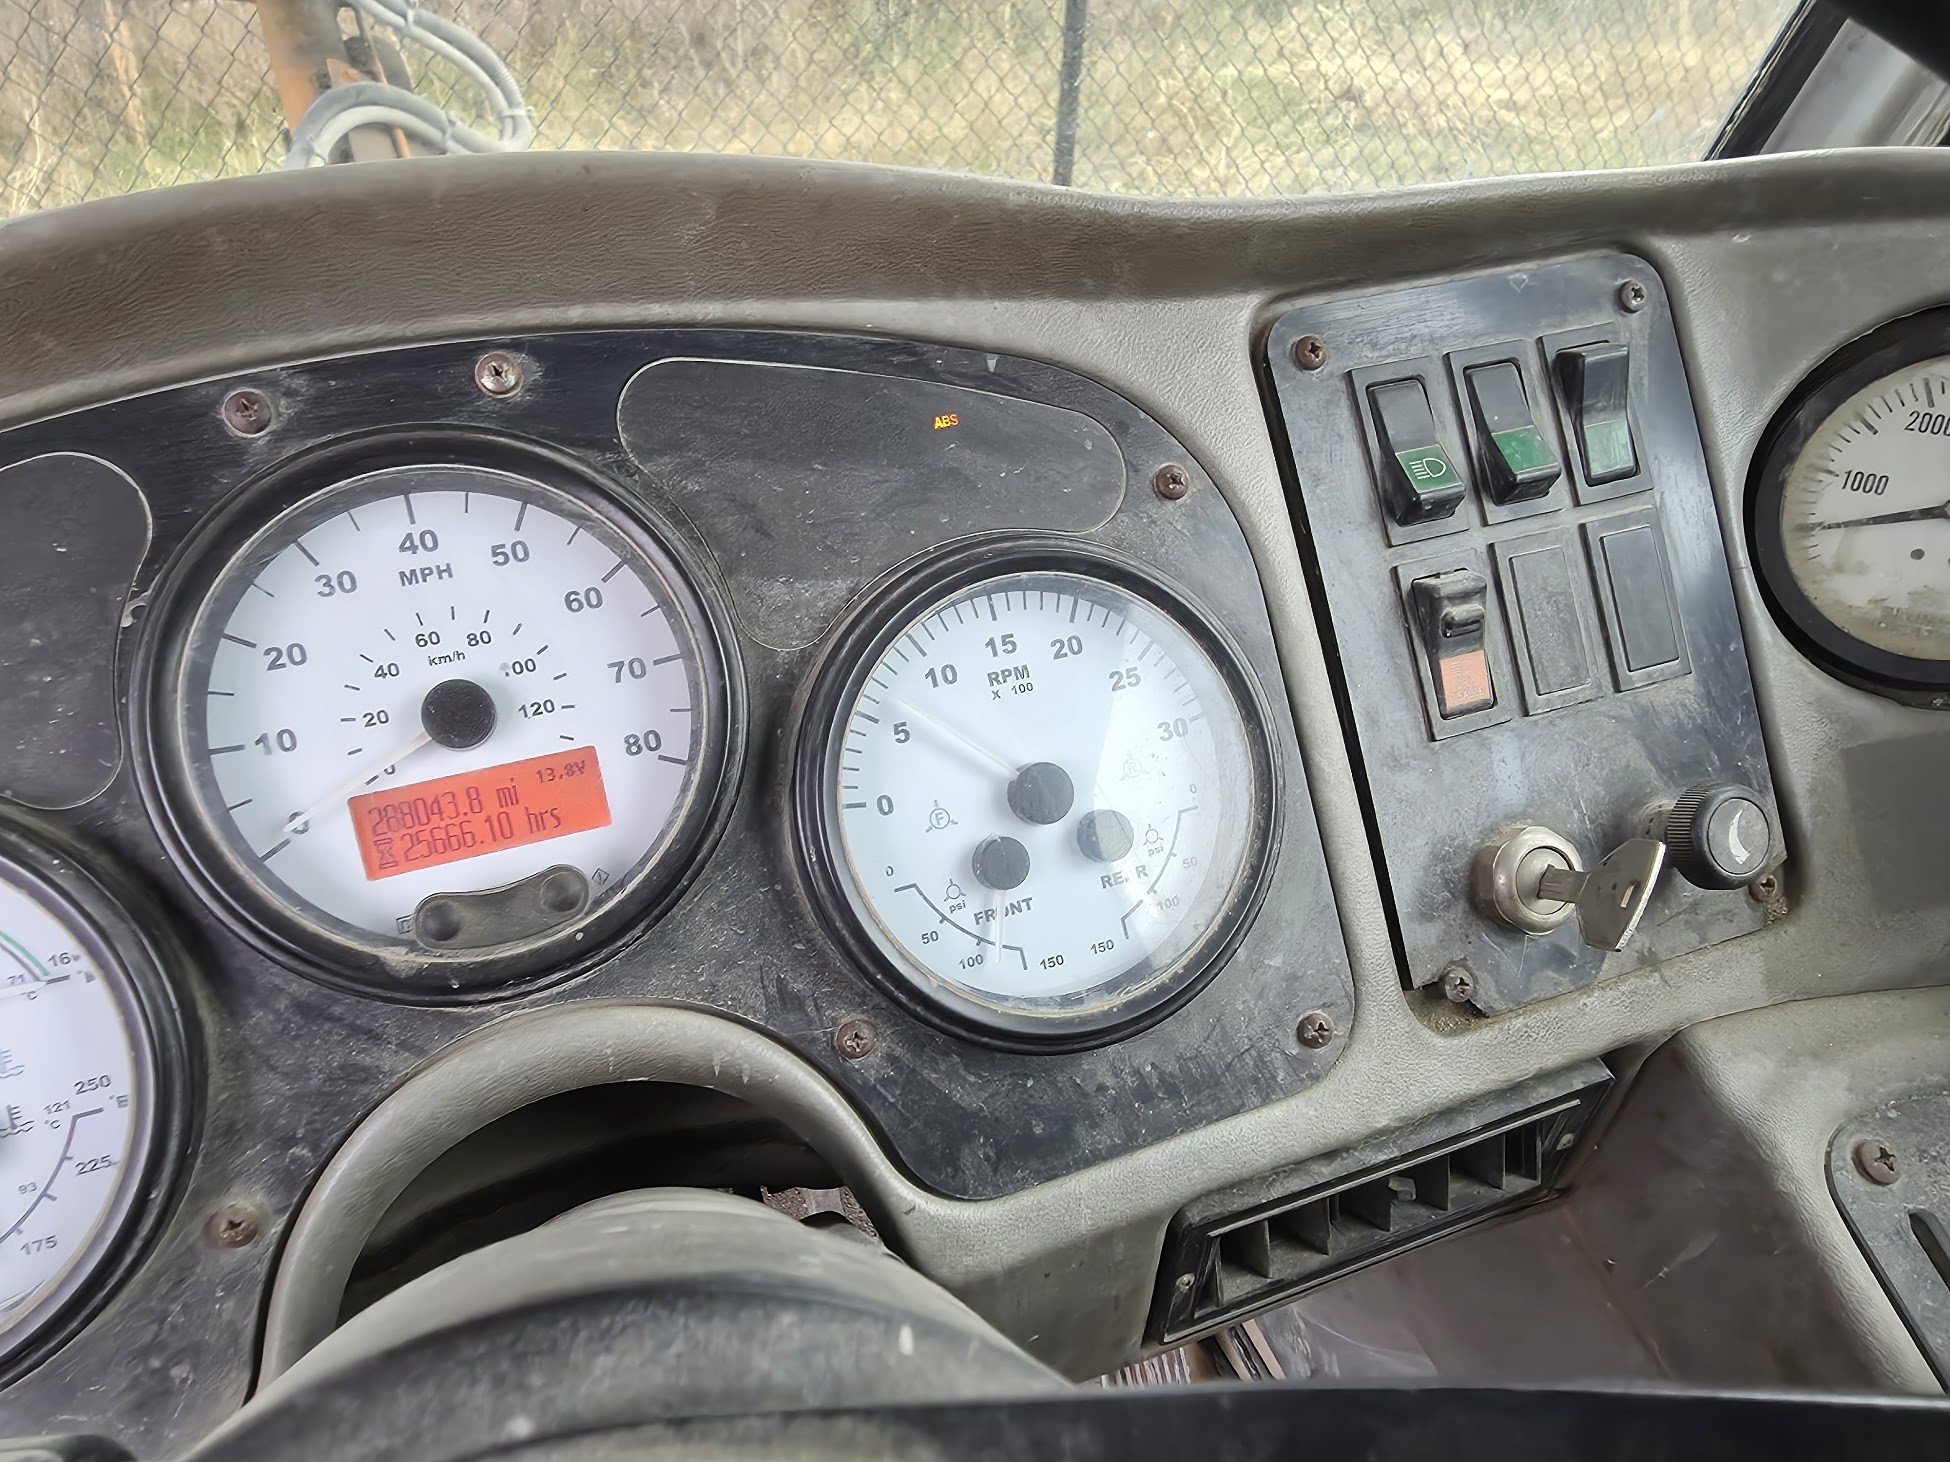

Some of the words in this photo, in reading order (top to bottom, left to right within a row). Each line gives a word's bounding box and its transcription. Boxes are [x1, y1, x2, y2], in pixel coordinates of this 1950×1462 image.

[933, 413, 959, 430] ABS
[1841, 469, 1889, 496] 1000
[398, 529, 439, 555] 40
[490, 540, 530, 567] 50
[314, 570, 357, 597] 30
[399, 562, 454, 588] MPH
[564, 586, 603, 613] 60
[414, 630, 441, 648] 60
[466, 630, 492, 648] 80
[984, 633, 1018, 657] 15
[1050, 635, 1083, 660] 20
[263, 642, 308, 672] 20
[427, 649, 466, 667] km/h
[374, 662, 400, 680] 40
[608, 657, 647, 685] 70
[924, 663, 958, 688] 10
[986, 664, 1031, 687] RPM
[1108, 666, 1142, 692] 25
[1011, 682, 1034, 695] 100
[362, 709, 390, 728] 20
[518, 699, 555, 719] 120
[893, 721, 911, 744] 5
[1157, 717, 1188, 742] 30
[254, 728, 297, 756] 10
[624, 730, 662, 756] 80
[1189, 783, 1197, 794] 0
[368, 786, 482, 836] 288043.8
[496, 777, 519, 808] mi
[876, 794, 894, 816] 0
[401, 811, 514, 862] 25666.10
[524, 806, 561, 834] hrs
[1148, 845, 1164, 857] psi
[886, 865, 894, 877] 0
[1182, 856, 1198, 869] 50
[1100, 864, 1148, 889] RER
[949, 899, 967, 914] psi
[1156, 895, 1180, 911] 100
[921, 930, 939, 945] 50
[1090, 939, 1115, 954] 150
[47, 951, 81, 968] 16
[958, 954, 984, 970] 100
[1039, 954, 1065, 970] 150
[73, 1074, 111, 1096] 250
[75, 1154, 113, 1176] 225
[18, 1181, 38, 1195] 93
[20, 1234, 58, 1255] 175
